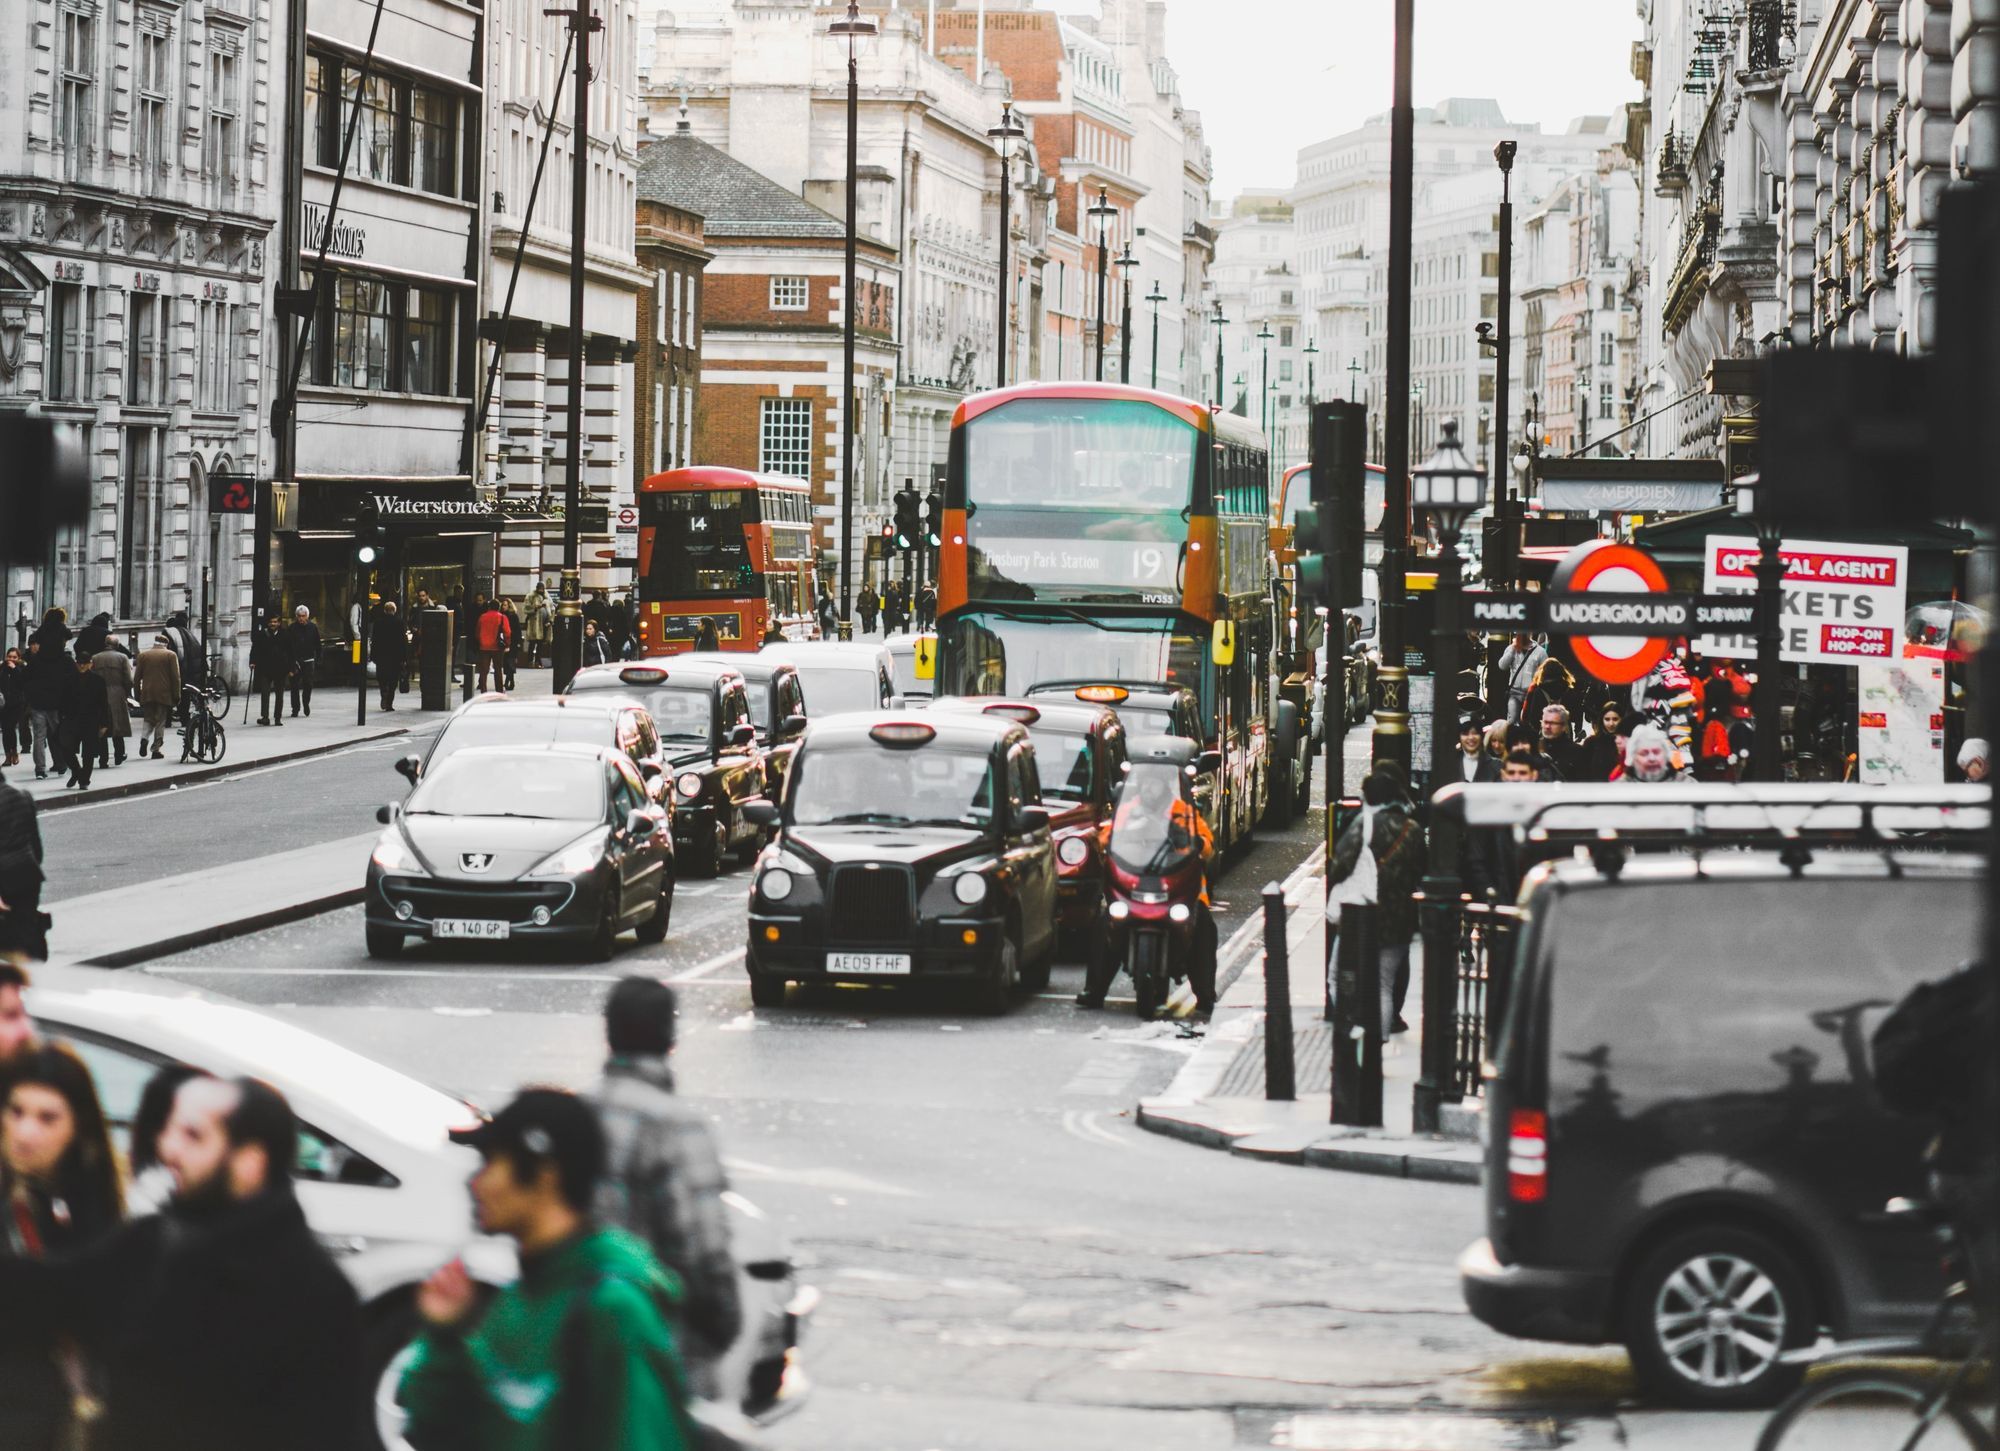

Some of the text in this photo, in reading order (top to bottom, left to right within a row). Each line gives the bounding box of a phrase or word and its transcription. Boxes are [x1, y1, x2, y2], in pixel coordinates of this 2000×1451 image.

[304, 204, 366, 258] Watrstones
[1602, 486, 1676, 500] MERIDIEN
[274, 491, 288, 528] W
[374, 495, 493, 515] Waterstones
[690, 516, 708, 531] 14
[985, 550, 1099, 571] Finsbury Park Station
[1132, 550, 1161, 579] 19
[1722, 553, 1890, 580] OFFAL AGENT
[1142, 594, 1174, 604] HV355
[1716, 587, 1874, 620] KETS
[1474, 602, 1754, 624] PUBLIC UNDERGROUND SUBWAY
[1830, 627, 1884, 641] HOP-ON
[1827, 640, 1886, 654] HOP-OFF
[441, 921, 455, 934] CK
[462, 922, 481, 935] 140
[486, 923, 500, 935] GP
[834, 956, 904, 970] AE09 FHF
